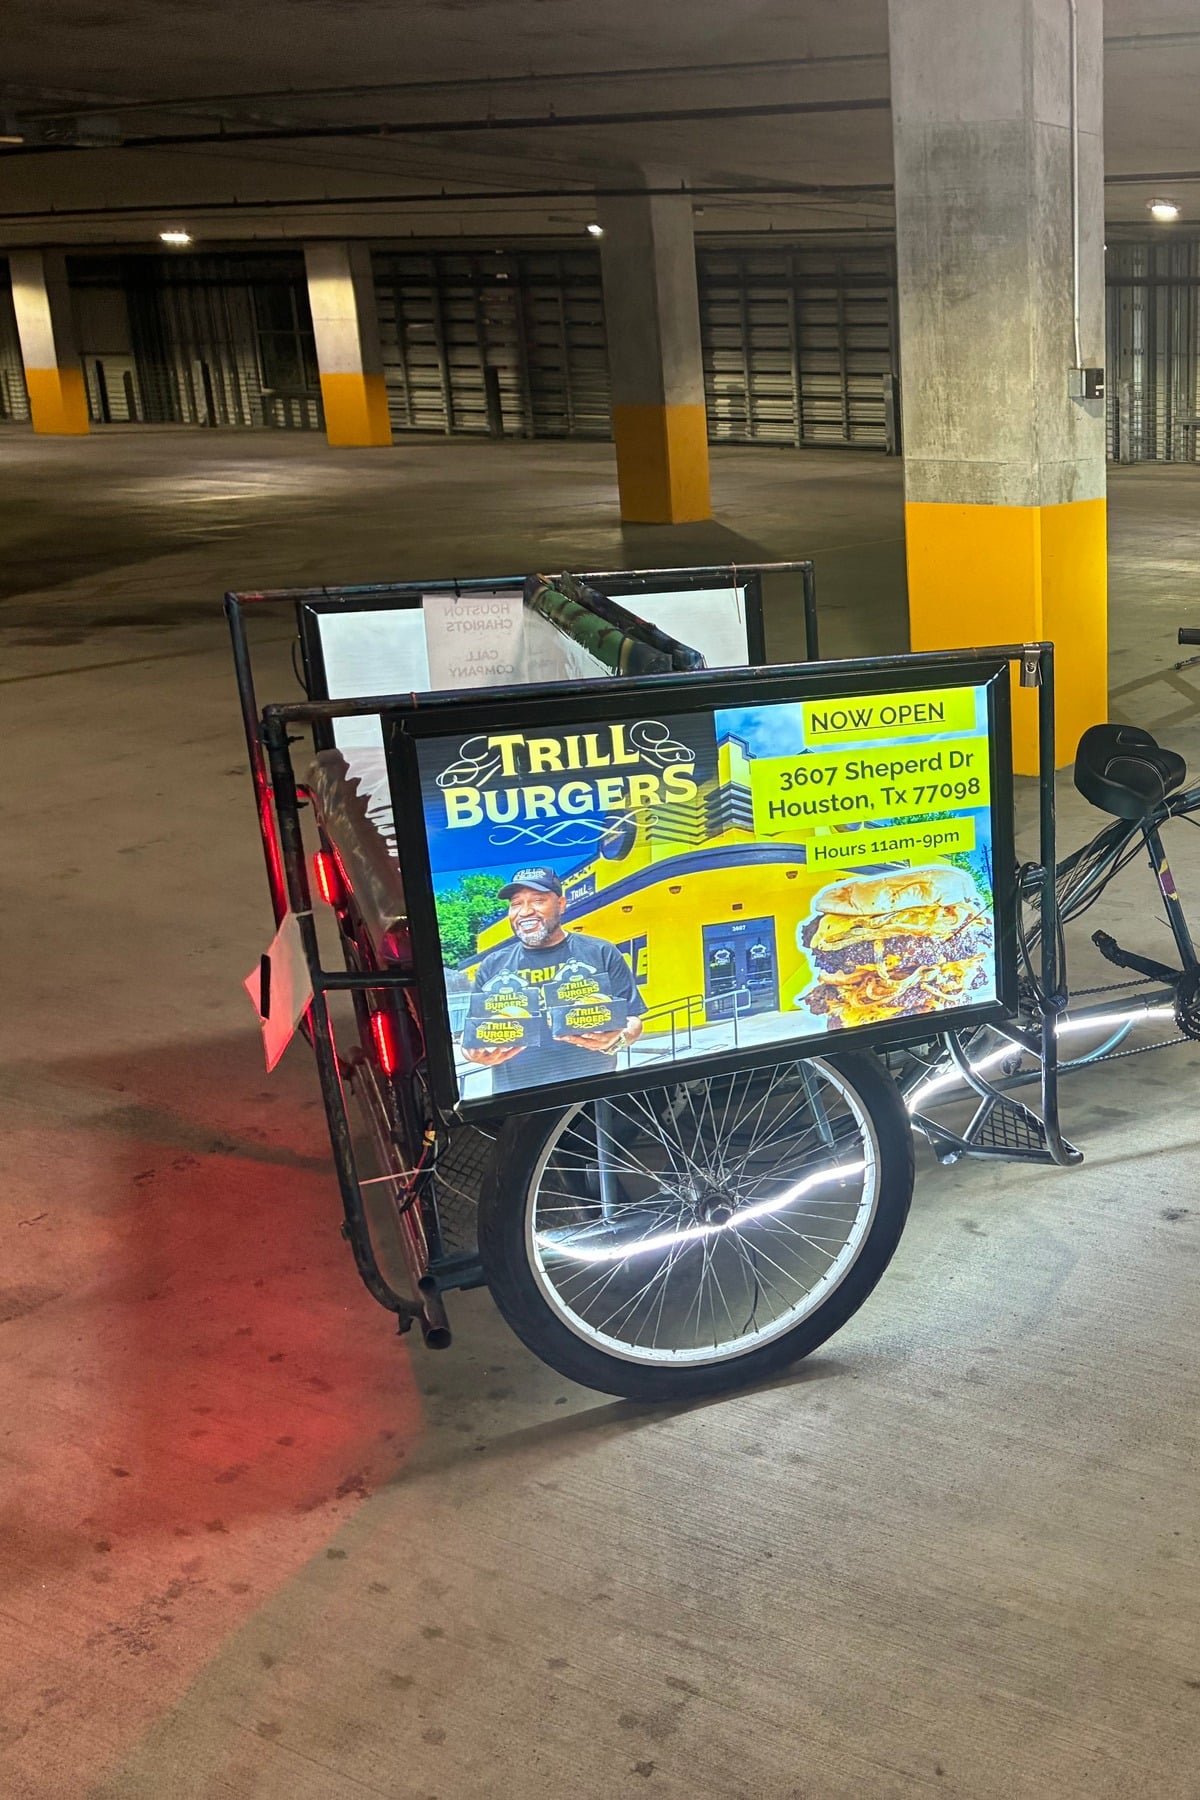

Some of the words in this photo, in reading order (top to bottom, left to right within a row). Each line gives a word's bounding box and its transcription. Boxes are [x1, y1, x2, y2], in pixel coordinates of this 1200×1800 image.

[811, 708, 873, 732] NOW
[880, 702, 944, 725] OPEN
[488, 724, 640, 777] TRILL
[779, 766, 838, 791] 3607
[845, 752, 942, 781] Sheperd
[950, 750, 974, 769] Dr
[441, 763, 698, 829] BURGERS
[769, 794, 875, 820] Houston,
[881, 787, 907, 806] Tx
[913, 777, 980, 805] 77098
[814, 842, 866, 861] Hours
[871, 831, 960, 854] 11am-9pm
[557, 984, 600, 999] BURGERS
[566, 979, 591, 990] TRILL
[494, 992, 518, 1001] TRILL
[485, 999, 528, 1010] BURGERS
[575, 1006, 601, 1016] TRILL
[486, 1021, 514, 1030] TRILL
[565, 1012, 612, 1025] BURGERS
[476, 1027, 524, 1039] BURGERS
